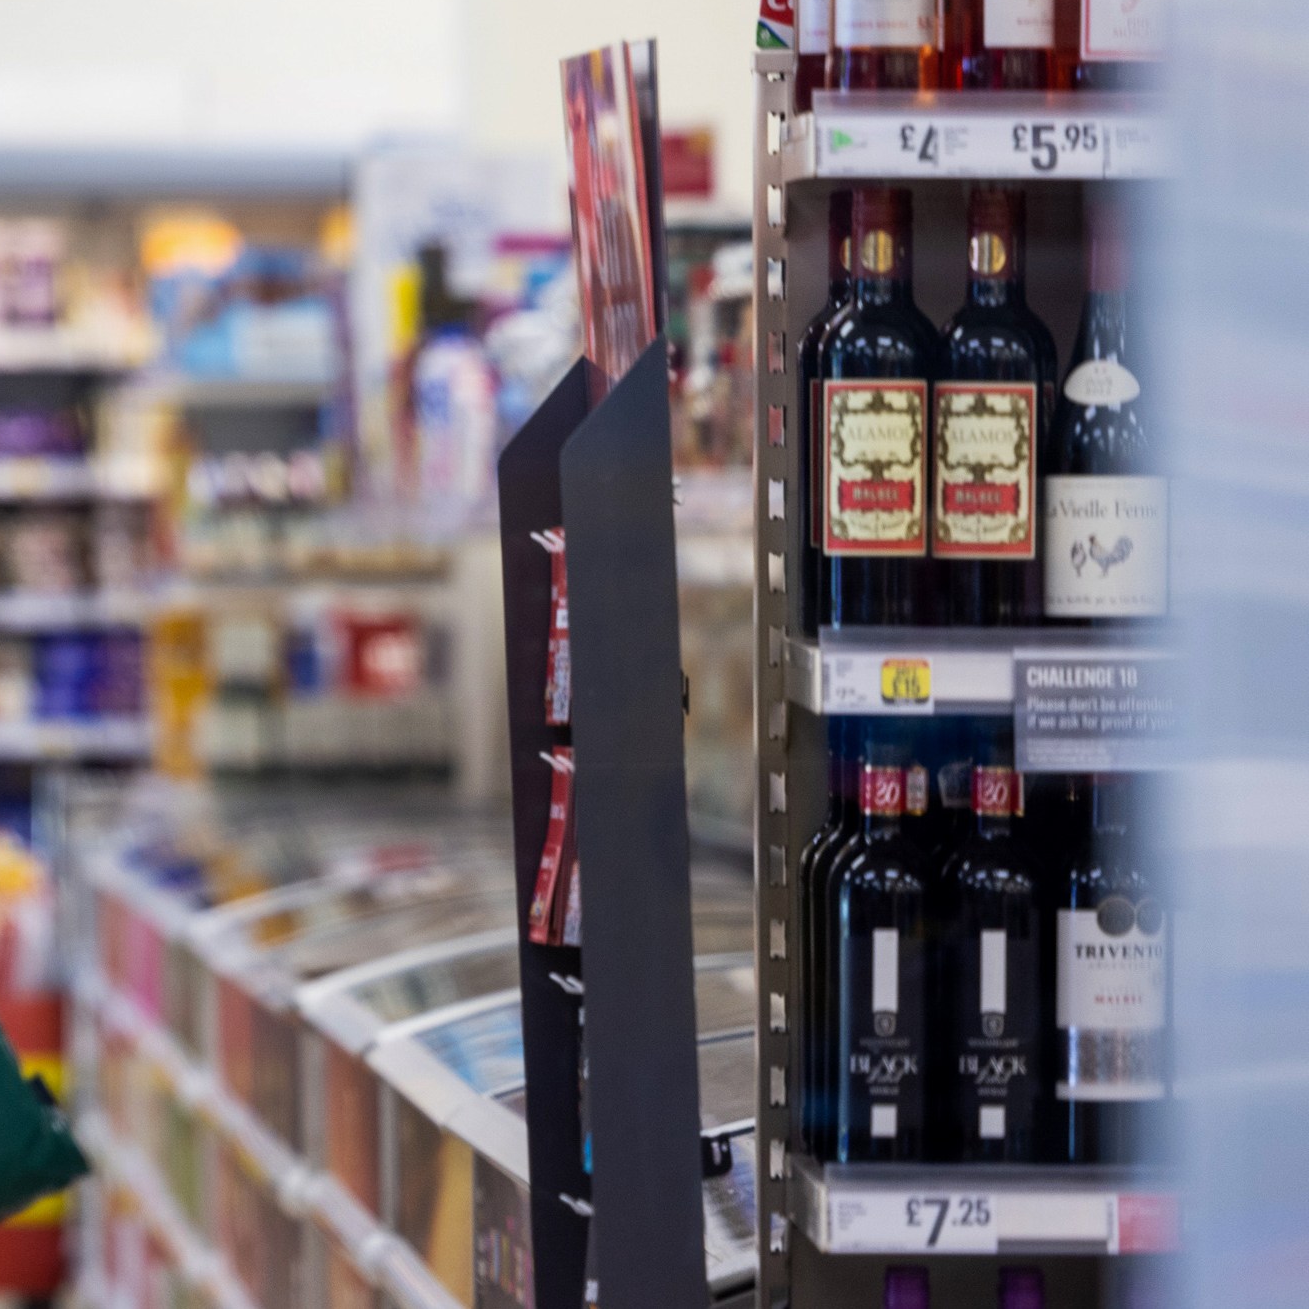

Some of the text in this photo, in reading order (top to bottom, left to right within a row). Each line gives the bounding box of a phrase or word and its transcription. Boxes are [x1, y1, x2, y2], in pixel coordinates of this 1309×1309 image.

[1011, 122, 1098, 172] £5.95
[1026, 666, 1115, 689] CHALLENGE
[1027, 695, 1066, 712] Please
[1074, 943, 1164, 961] TRIVENTO
[849, 1053, 919, 1075] BLACK
[958, 1054, 1028, 1076] BLACK
[905, 1196, 992, 1248] £7.25
